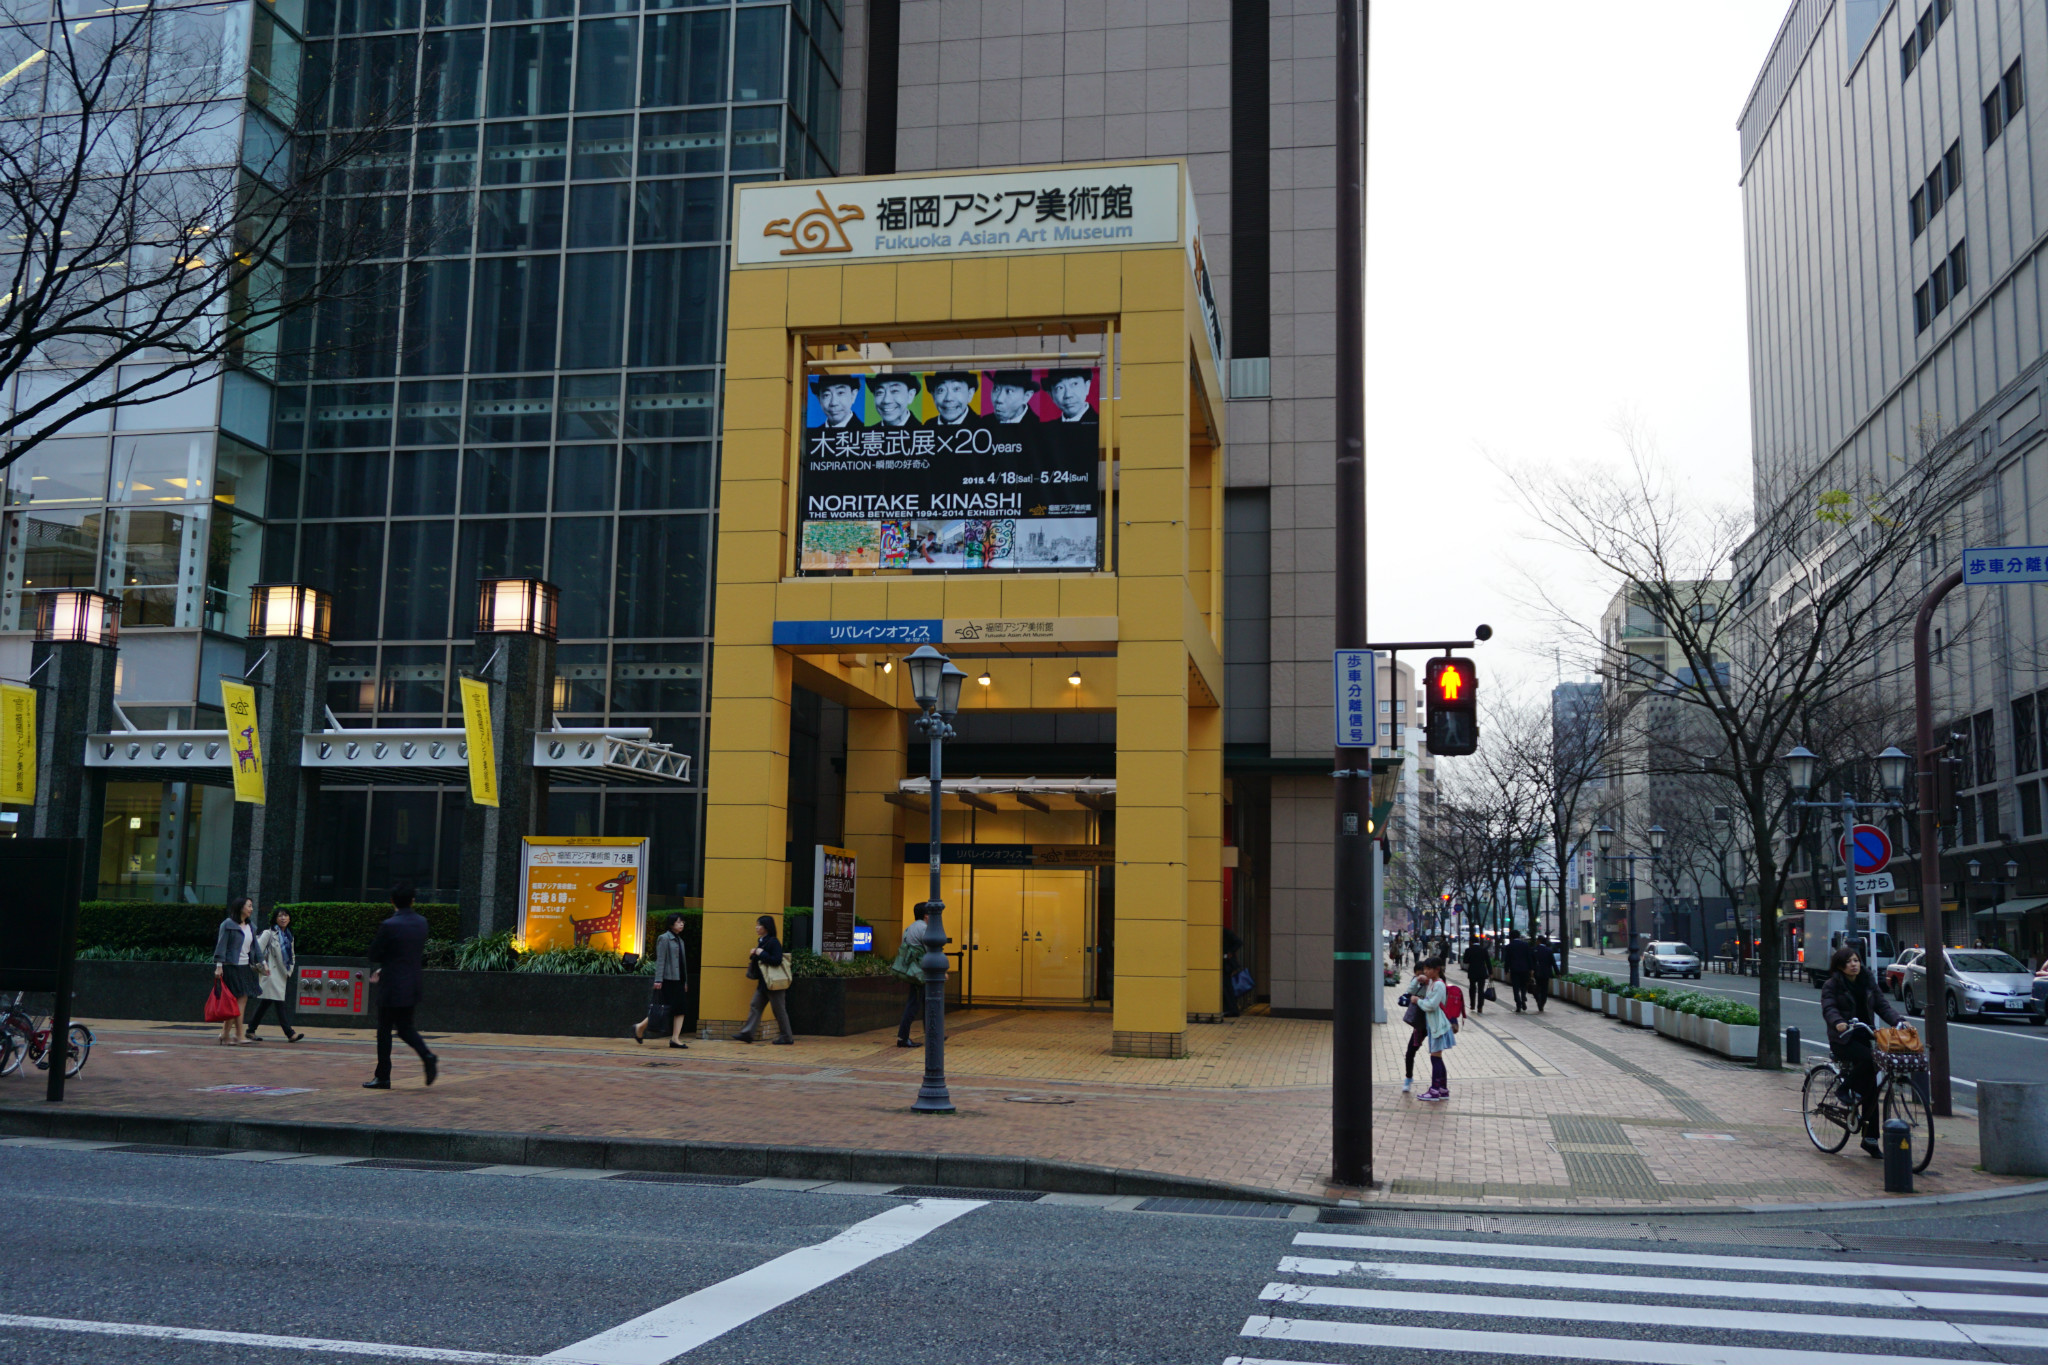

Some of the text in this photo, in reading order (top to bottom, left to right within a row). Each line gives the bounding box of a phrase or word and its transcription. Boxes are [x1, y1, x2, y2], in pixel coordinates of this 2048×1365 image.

[876, 184, 1133, 231] 福岡アジア美術館
[875, 225, 1133, 250] Fukuoka Asian Art Museum
[962, 476, 986, 485] 2015.
[808, 492, 1022, 511] NORITAKE KINASHI
[829, 510, 866, 518] WORKS
[867, 510, 915, 518] BETWEEN
[916, 509, 964, 517] 1994-2014
[967, 508, 1021, 517] EXHIBITION
[1969, 557, 2048, 575] 歩車分離
[830, 625, 930, 639] リバレインオフィス
[985, 622, 1054, 632] 福岡アジア美術館
[1347, 655, 1364, 742] 歩車分離信号
[557, 851, 611, 860] 福岡アジア美術館
[956, 850, 1024, 859] リバレインオフィス
